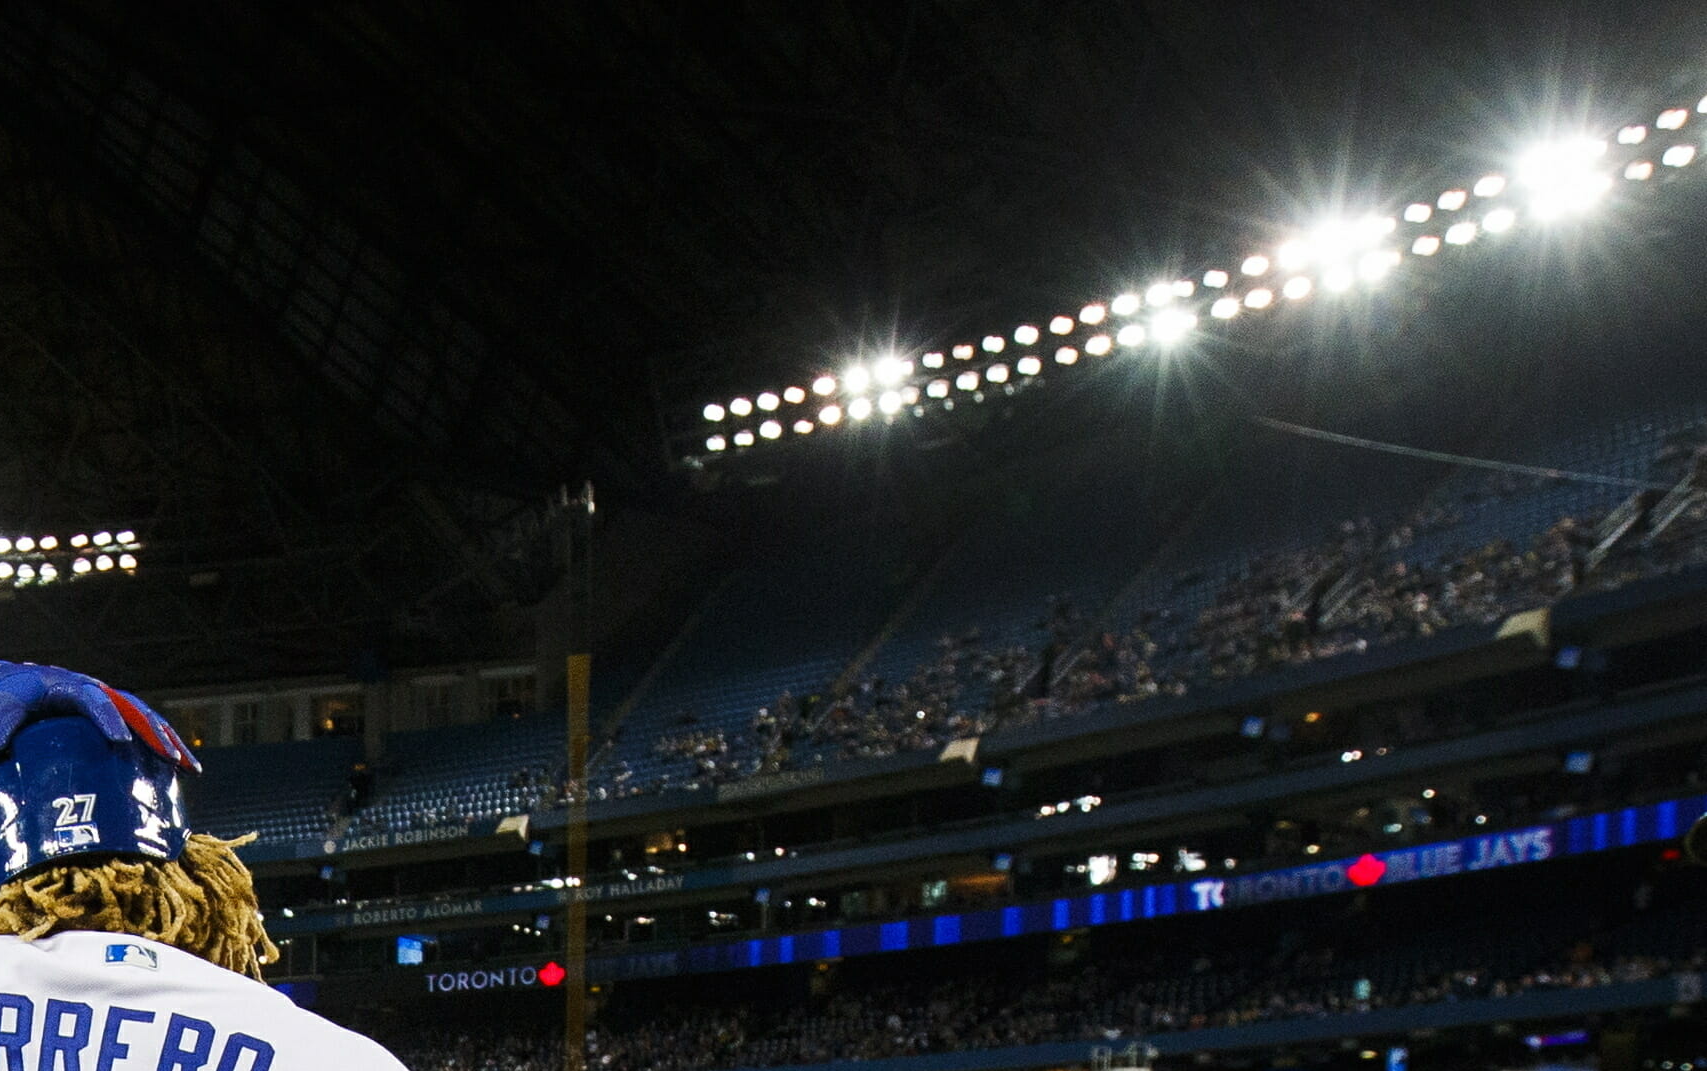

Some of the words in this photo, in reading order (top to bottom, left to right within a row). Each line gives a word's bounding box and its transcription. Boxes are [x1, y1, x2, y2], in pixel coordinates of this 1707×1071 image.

[52, 793, 97, 827] 27
[342, 833, 389, 851] JACKIE
[395, 825, 469, 845] ROBINSON
[1467, 829, 1553, 872] JAYS
[610, 875, 684, 898] HALLADAY
[353, 907, 418, 925] ROBERTO
[423, 899, 483, 919] ALOMAR
[425, 965, 537, 992] TORONTO
